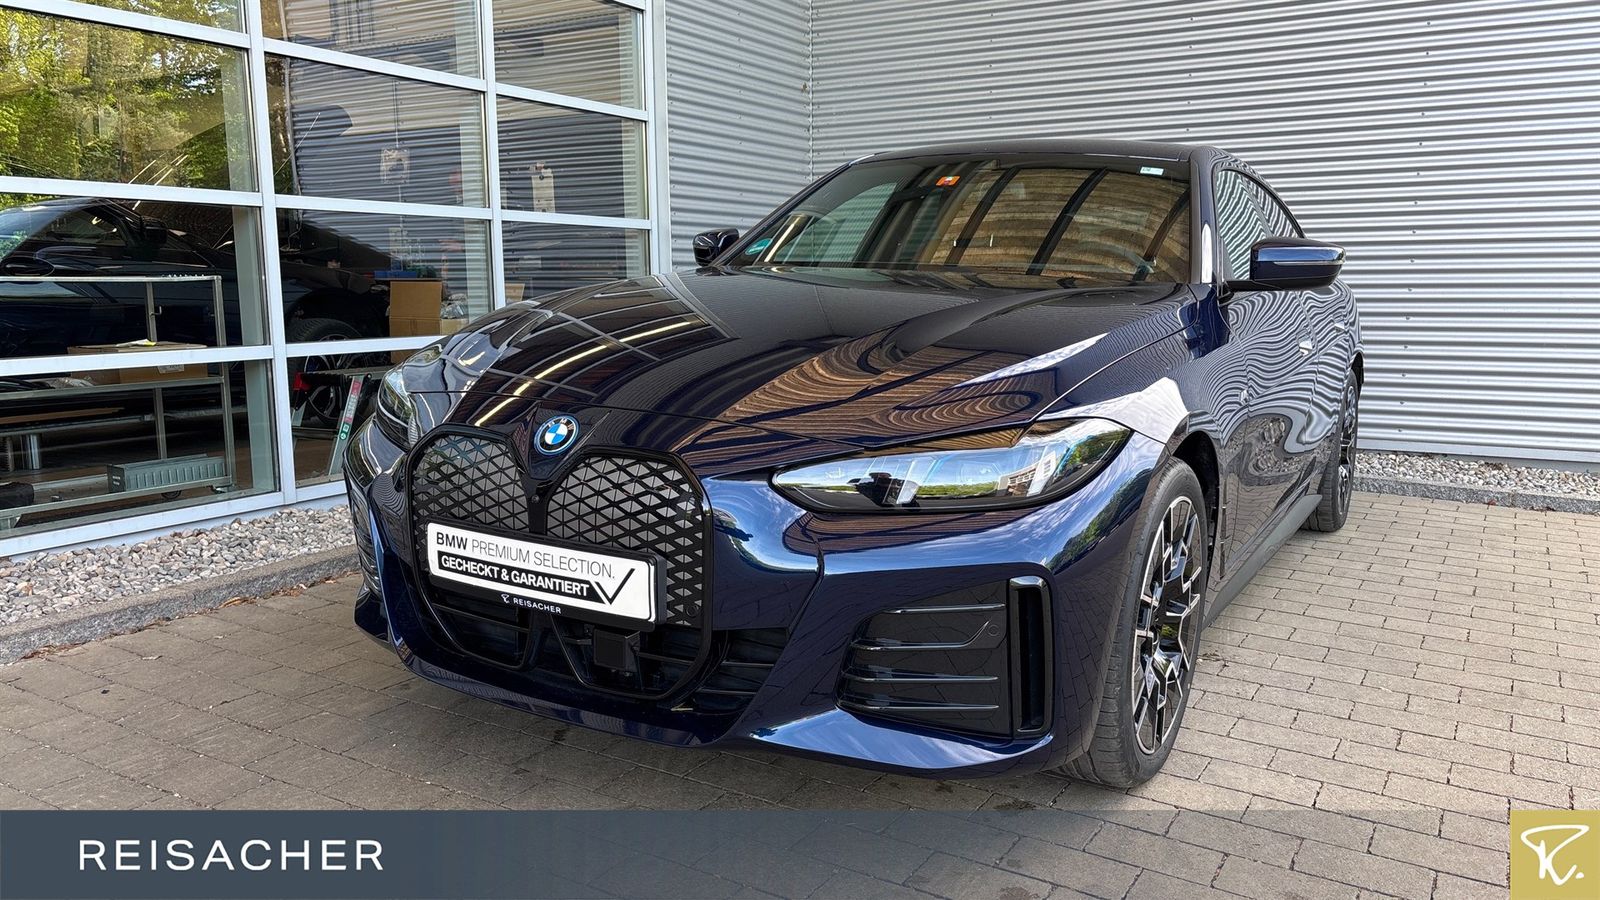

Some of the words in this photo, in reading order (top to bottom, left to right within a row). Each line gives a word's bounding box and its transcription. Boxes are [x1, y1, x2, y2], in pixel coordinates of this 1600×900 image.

[548, 417, 575, 431] BMW
[436, 531, 468, 551] BMW
[471, 539, 530, 564] PREMIUM
[533, 552, 616, 579] SELECTION.
[441, 554, 500, 579] GECHECKT
[501, 568, 510, 581] &
[511, 571, 590, 597] GARANTIERT
[513, 597, 562, 614] REISACHER
